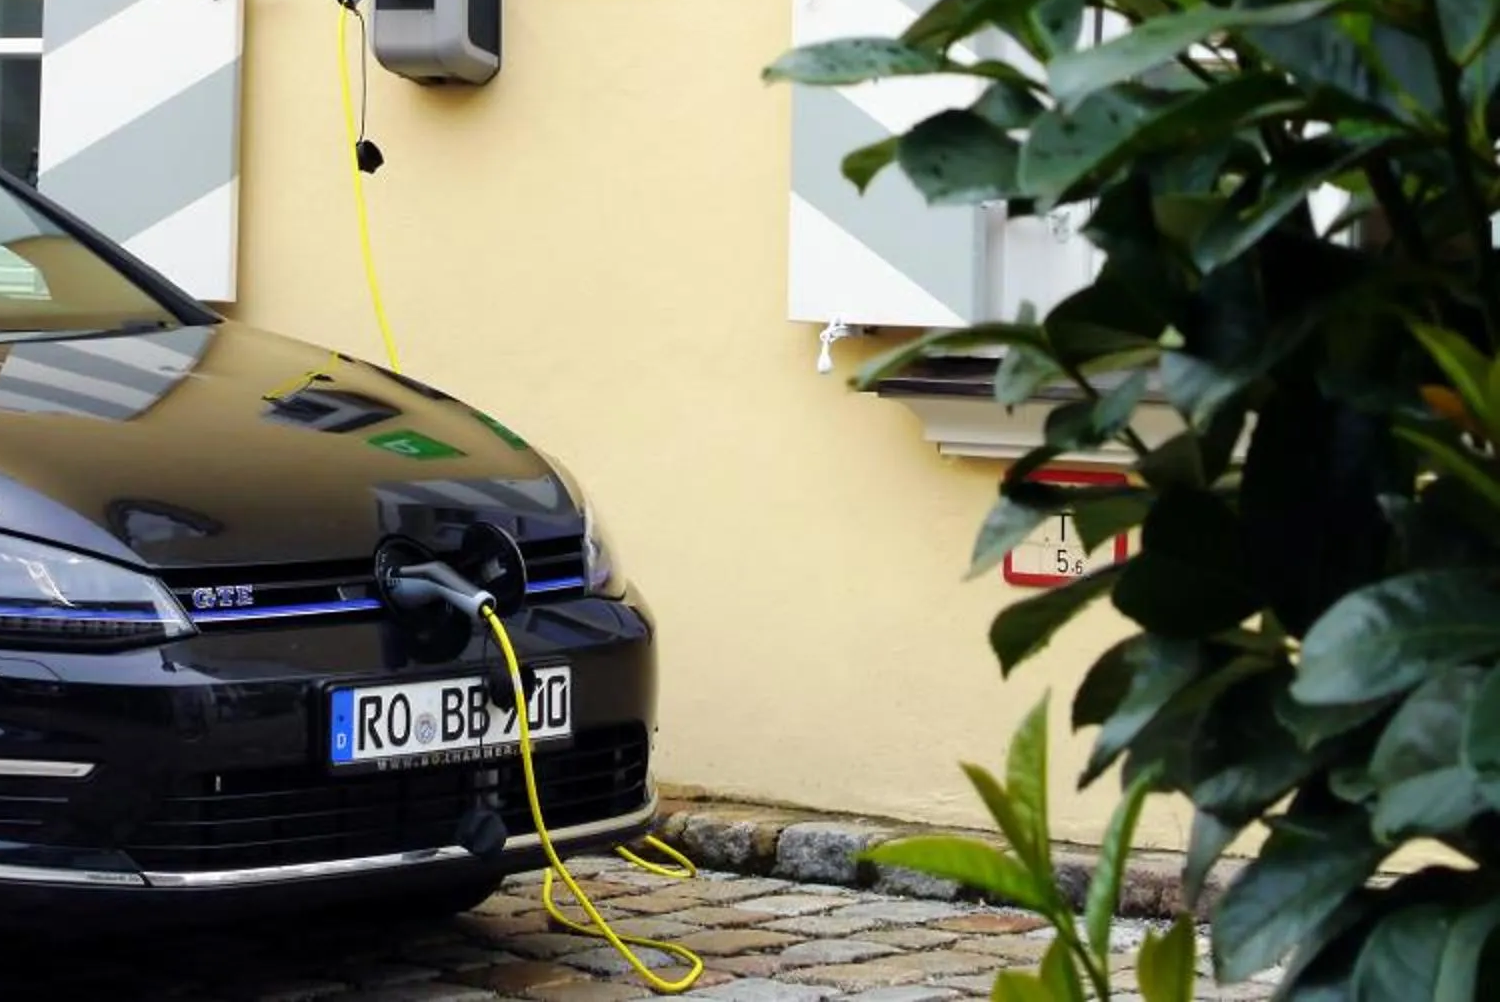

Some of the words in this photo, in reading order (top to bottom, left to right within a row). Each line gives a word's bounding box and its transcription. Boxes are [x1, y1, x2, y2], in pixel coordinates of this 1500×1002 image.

[192, 584, 254, 609] GTE
[358, 692, 412, 751] RO
[441, 685, 491, 743] BB
[336, 733, 347, 748] D
